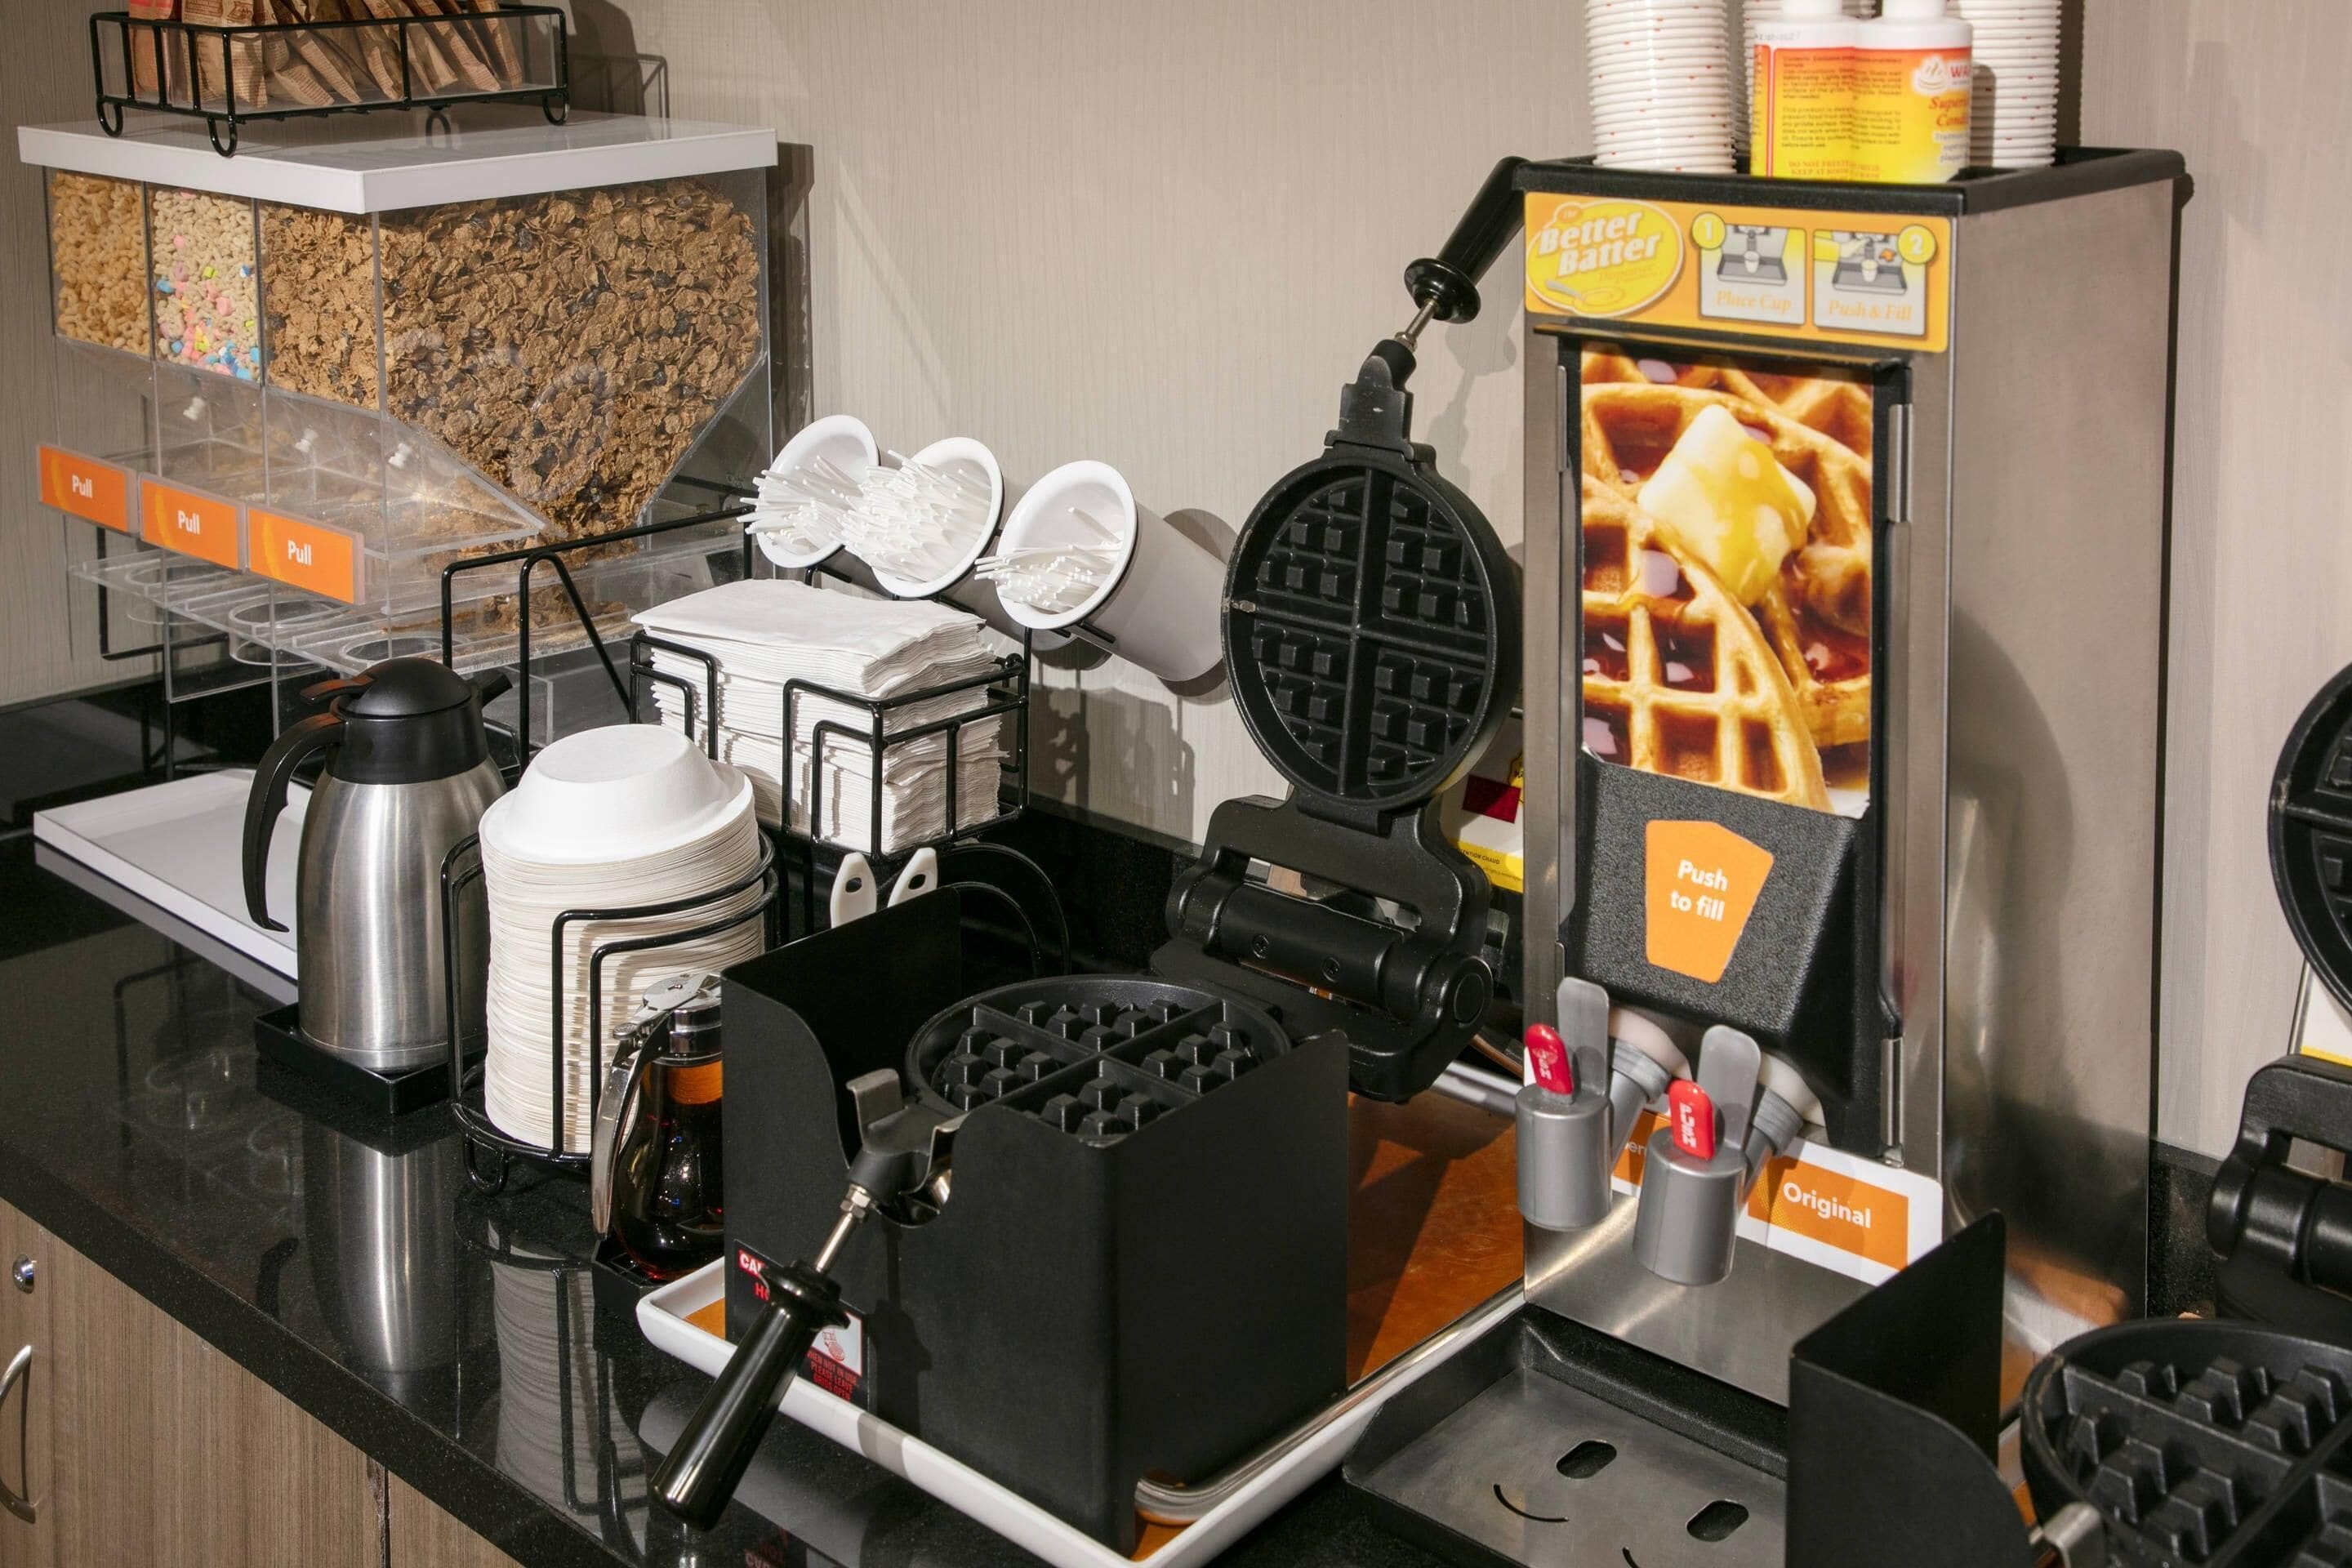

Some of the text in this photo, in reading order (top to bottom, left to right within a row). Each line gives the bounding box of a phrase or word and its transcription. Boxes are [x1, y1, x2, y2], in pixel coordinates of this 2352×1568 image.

[1538, 211, 1644, 256] Better
[1704, 220, 1713, 240] 1
[1557, 234, 1662, 278] Batter
[1909, 234, 1923, 255] 2
[1716, 290, 1792, 314] Place Cup
[1828, 300, 1865, 317] Push
[1880, 304, 1912, 321] Fill
[72, 474, 92, 498] Pull
[177, 510, 200, 535] Pull
[287, 540, 312, 566] Pull
[1677, 858, 1729, 892] Push
[1670, 890, 1726, 922] to fill
[1679, 1102, 1697, 1149] PUSH
[1783, 1181, 1872, 1229] Original
